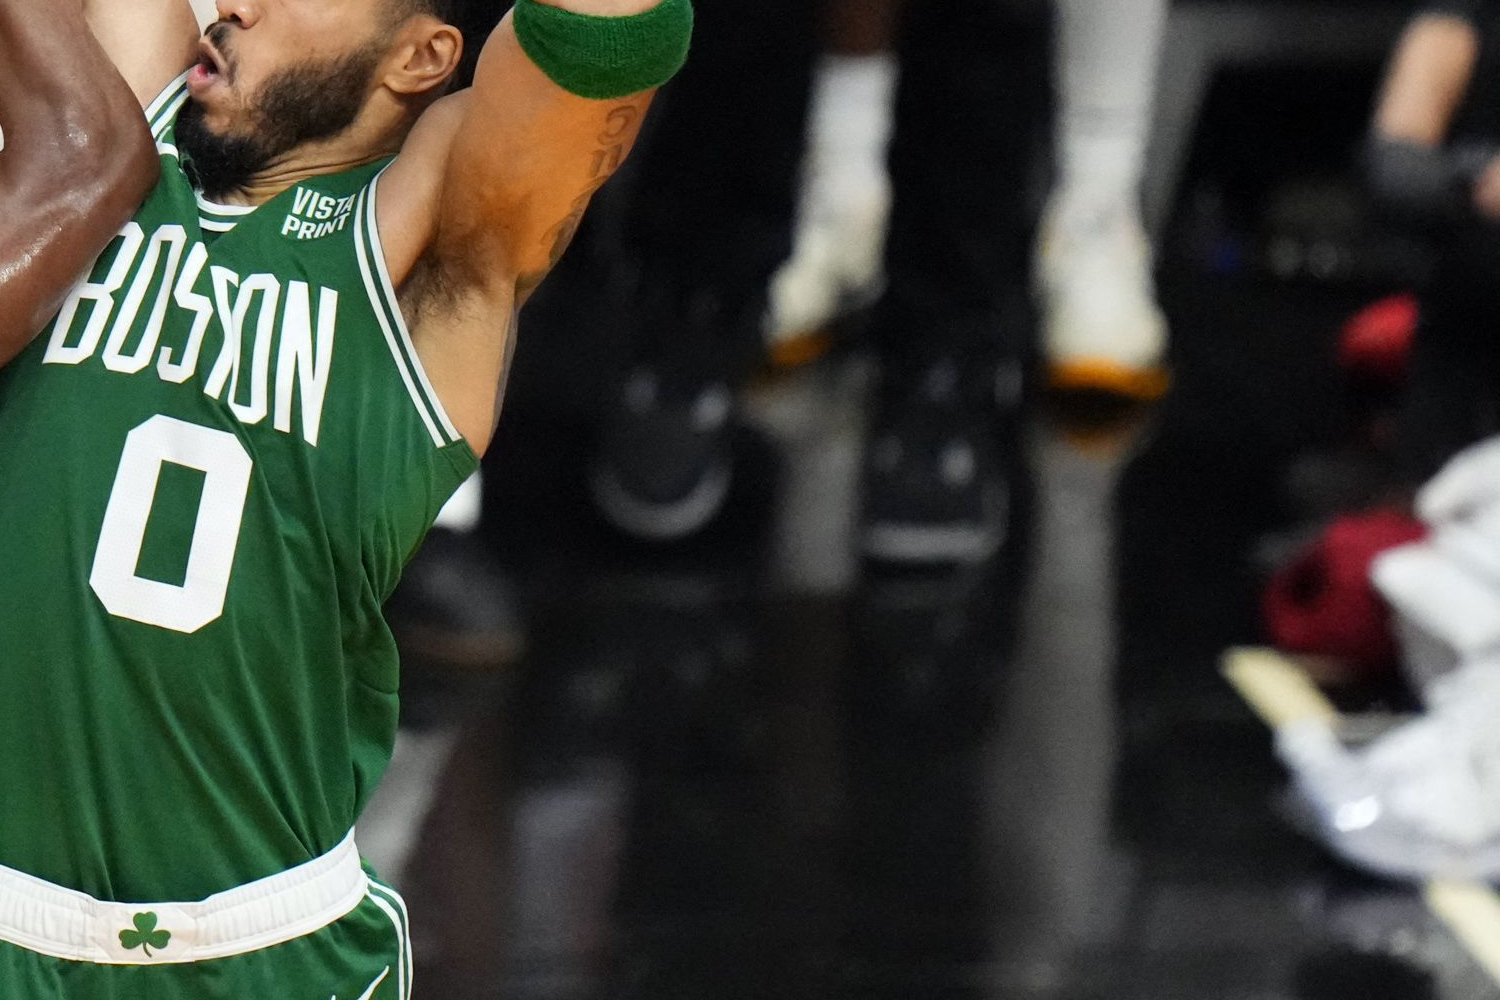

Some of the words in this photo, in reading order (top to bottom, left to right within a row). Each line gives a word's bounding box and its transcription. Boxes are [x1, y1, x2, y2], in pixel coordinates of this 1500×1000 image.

[281, 212, 350, 239] PRINT
[292, 186, 356, 219] VISTA
[42, 221, 338, 447] BOSTON
[89, 413, 254, 634] 0
